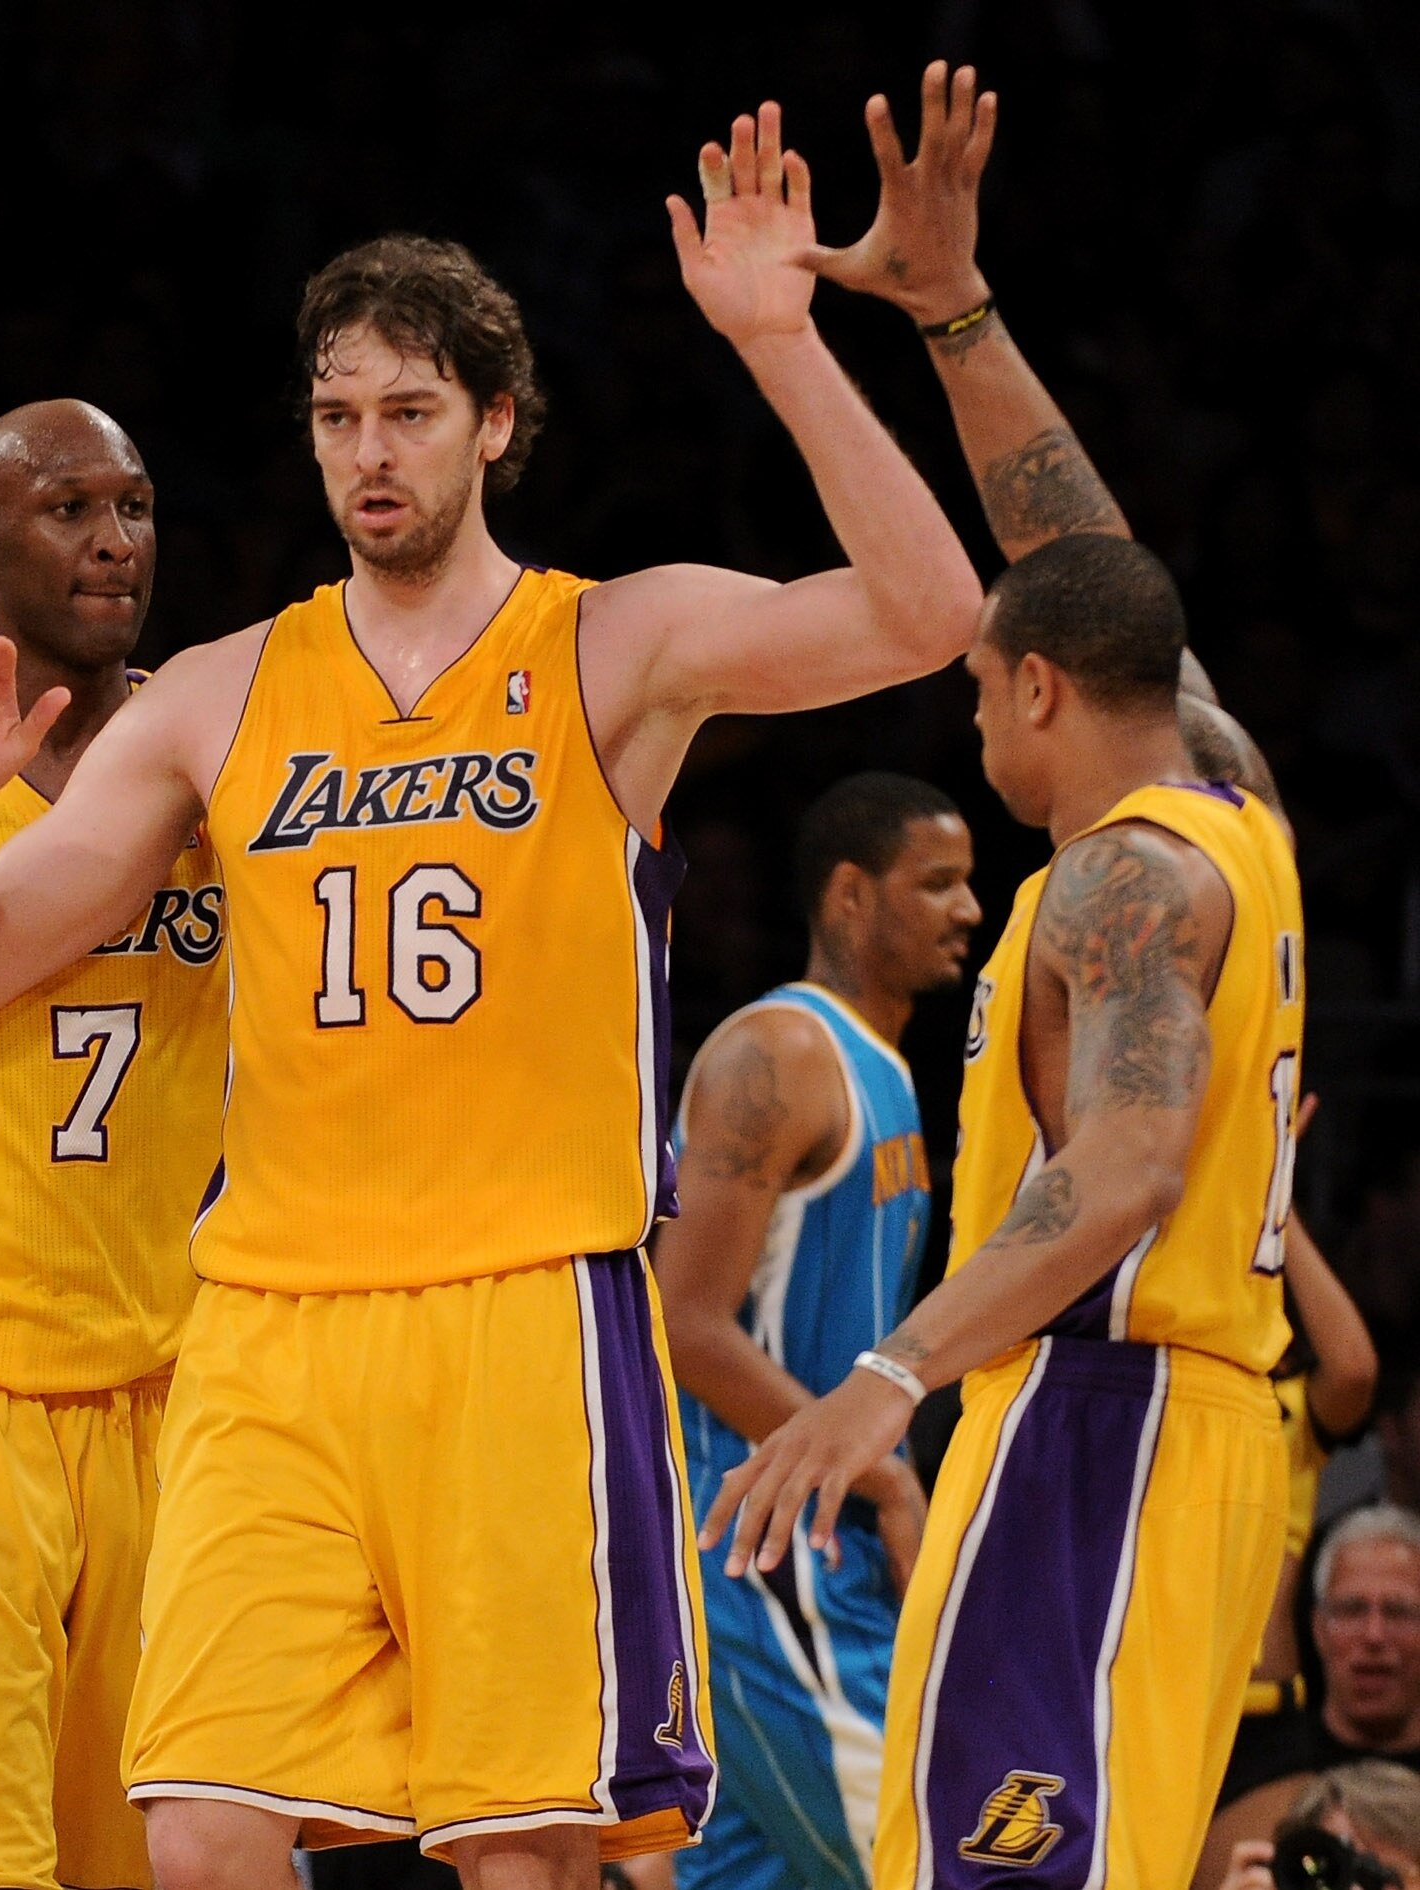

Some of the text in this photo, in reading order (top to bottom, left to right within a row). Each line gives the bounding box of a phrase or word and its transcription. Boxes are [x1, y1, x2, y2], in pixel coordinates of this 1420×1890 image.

[246, 748, 541, 855] LAKERS
[313, 863, 483, 1028] 16
[50, 1002, 143, 1163] 7
